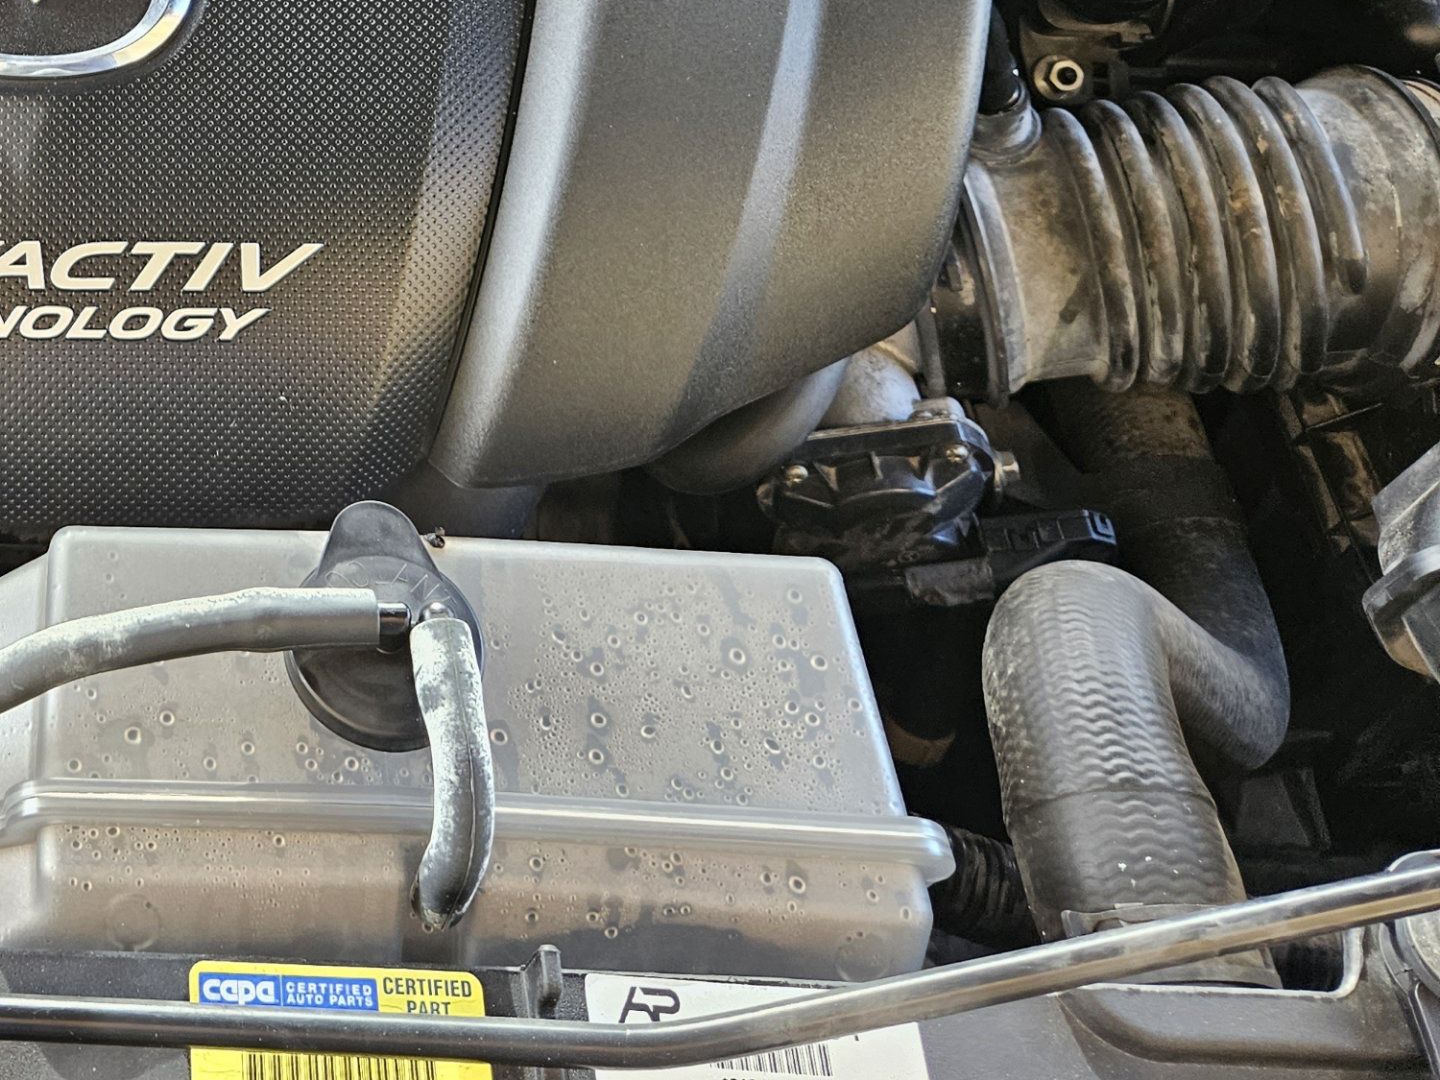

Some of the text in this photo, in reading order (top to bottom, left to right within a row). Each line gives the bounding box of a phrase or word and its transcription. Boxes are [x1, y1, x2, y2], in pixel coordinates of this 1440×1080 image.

[324, 557, 458, 607] OOLANT
[202, 978, 277, 1006] capa
[285, 981, 373, 996] CERTIFIED
[382, 976, 473, 998] CERTIFIED
[286, 993, 374, 1008] AUTO PARTS
[406, 1000, 451, 1016] PART
